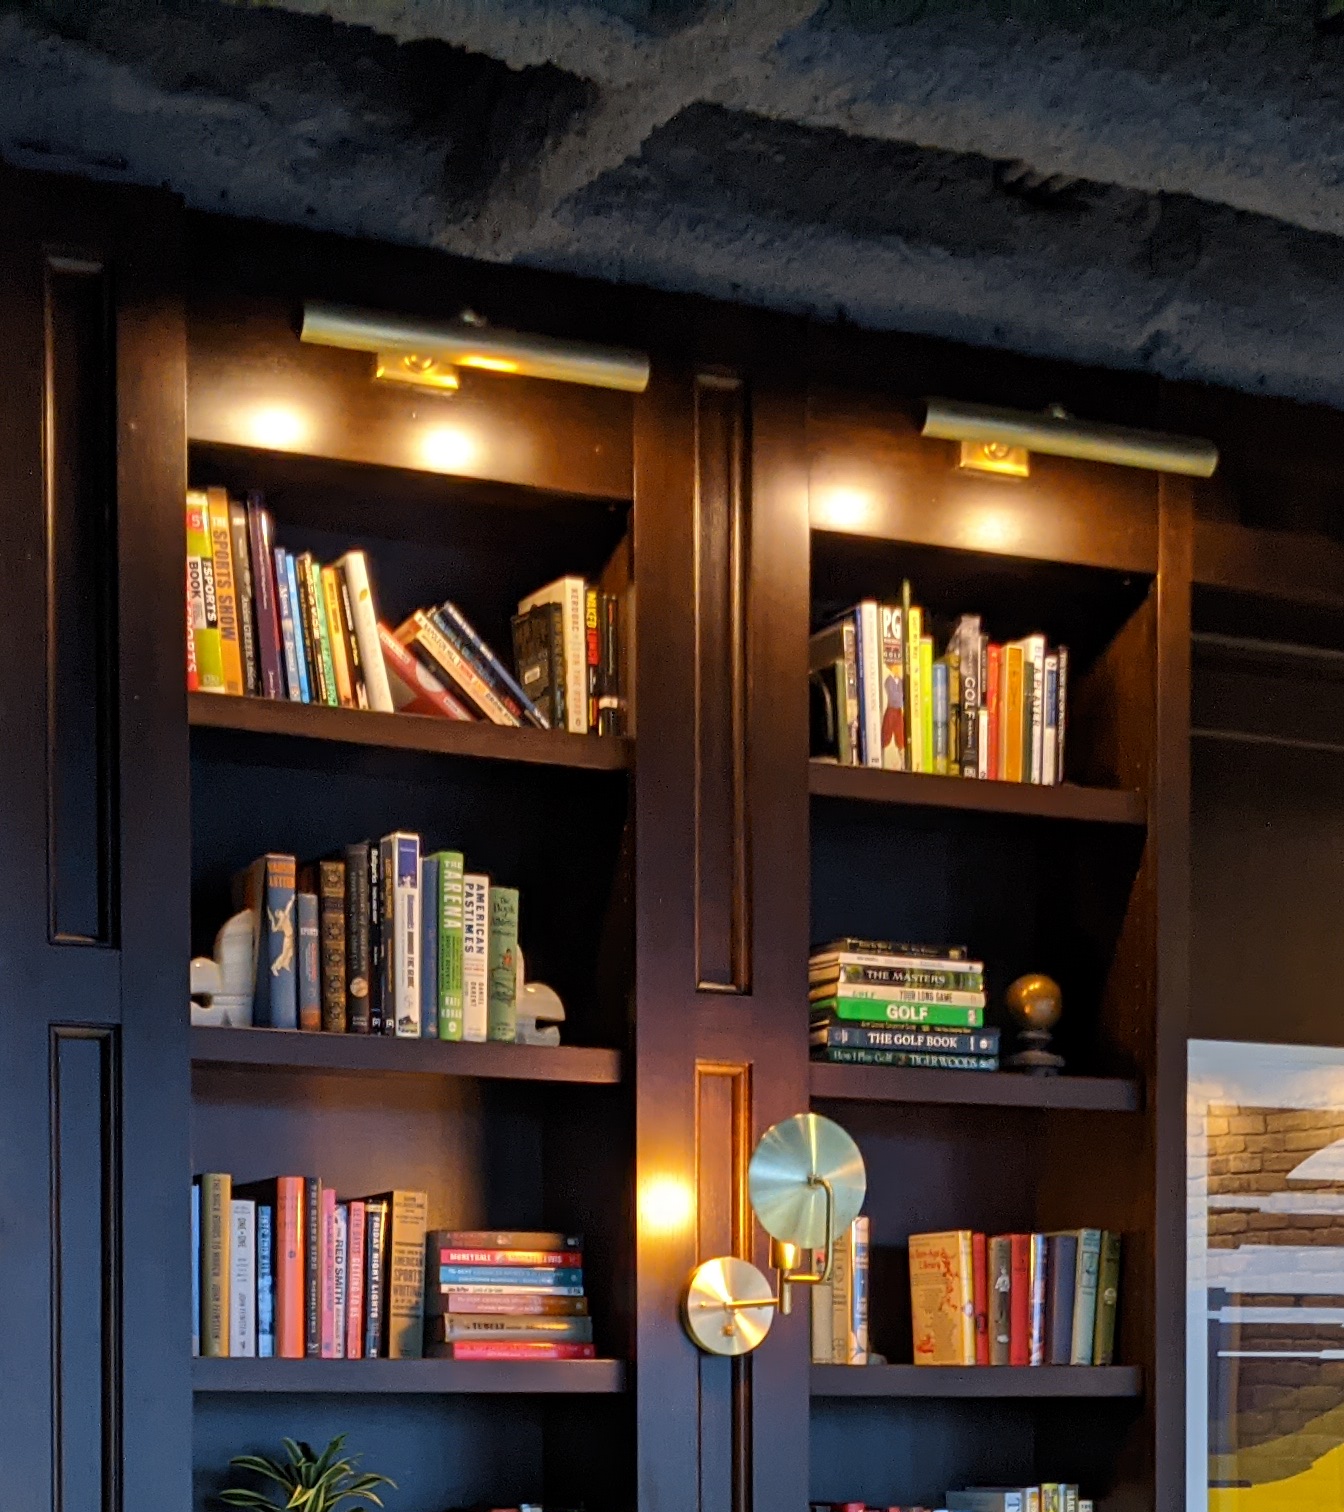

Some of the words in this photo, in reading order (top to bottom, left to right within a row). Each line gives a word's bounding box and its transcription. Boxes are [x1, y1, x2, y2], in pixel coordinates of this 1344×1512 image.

[213, 530, 233, 587] SPORTS
[189, 561, 201, 598] BOOK
[204, 566, 217, 622] SPORTS
[219, 595, 237, 641] SHOW
[571, 588, 580, 631] KEROUAC
[587, 591, 597, 629] NAKED
[964, 676, 977, 719] GOLF
[1032, 679, 1042, 727] PLAYER
[443, 870, 463, 929] ARENA
[464, 882, 475, 953] PASTIMES
[475, 883, 485, 955] AMERICAN
[867, 970, 889, 980] THE
[891, 972, 945, 984] MASTERS
[886, 1004, 928, 1021] GOLF
[917, 992, 934, 1002] LONG
[867, 1032, 892, 1045] THE
[894, 1034, 925, 1047] GOLF
[926, 1035, 958, 1049] BOOK
[909, 1055, 936, 1066] TIGER
[936, 1056, 977, 1068] WOODS
[371, 1216, 380, 1249] FRIDAY
[335, 1239, 344, 1265] RED
[371, 1252, 380, 1282] NIGHT
[335, 1267, 344, 1306] SMITH
[351, 1257, 361, 1293] GETTING
[351, 1295, 360, 1305] TO
[351, 1307, 360, 1318] US
[371, 1284, 380, 1319] LIGHTS
